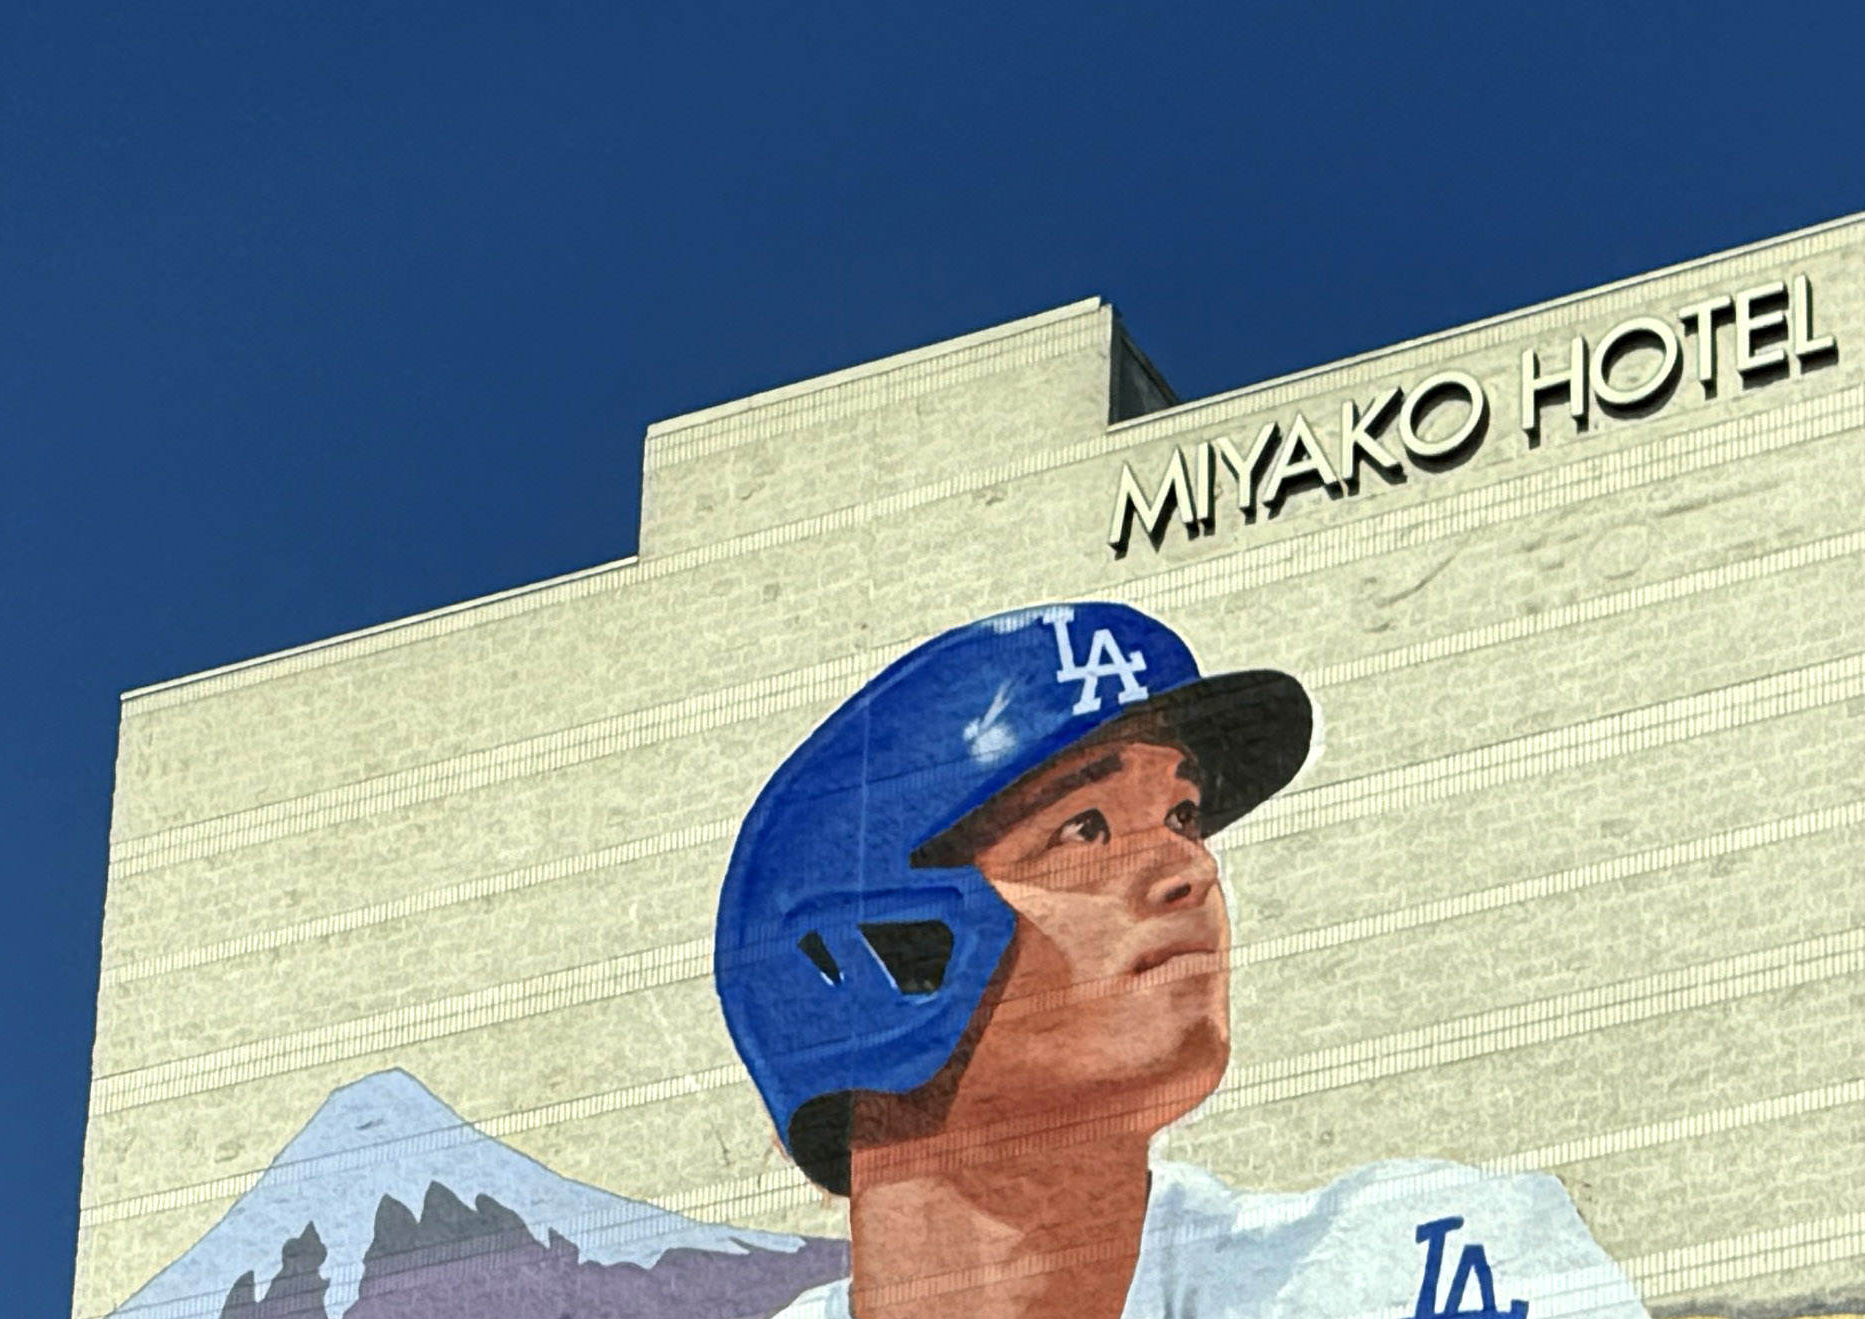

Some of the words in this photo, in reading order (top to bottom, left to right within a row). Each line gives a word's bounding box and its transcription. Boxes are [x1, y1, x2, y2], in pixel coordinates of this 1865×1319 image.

[1108, 369, 1486, 556] MIYAKO
[1521, 274, 1835, 446] HOTEL
[1042, 605, 1149, 716] LA
